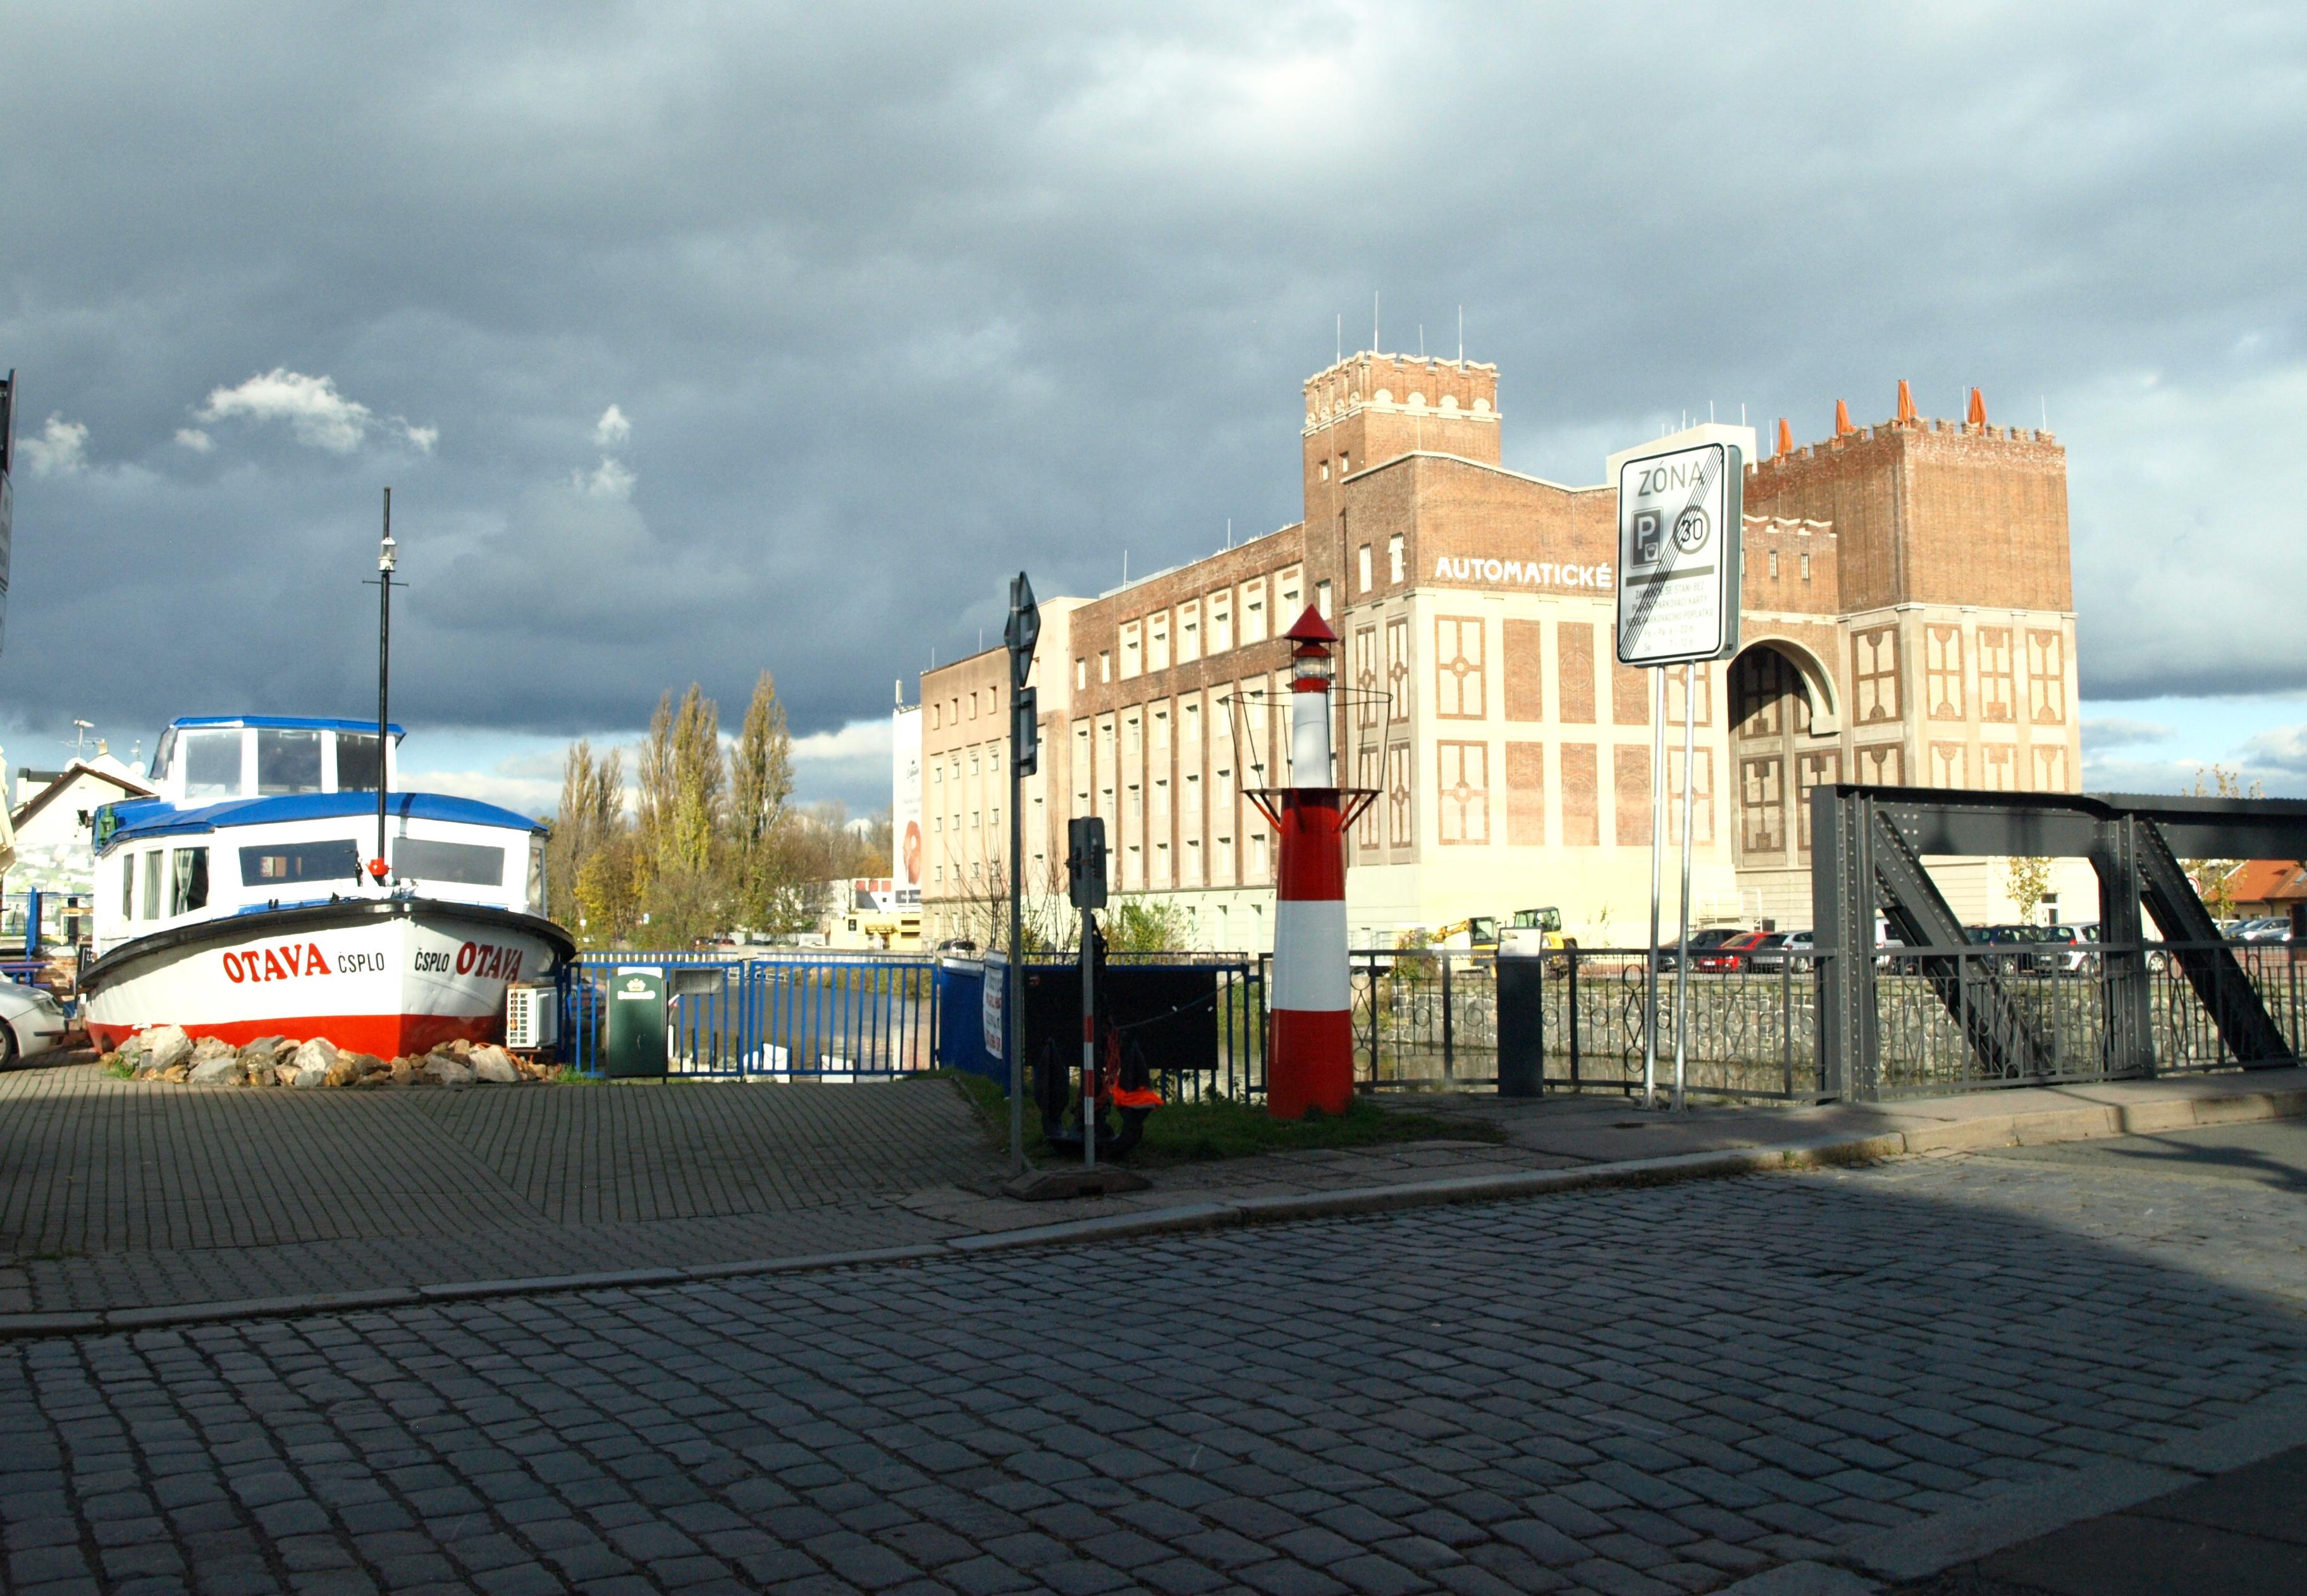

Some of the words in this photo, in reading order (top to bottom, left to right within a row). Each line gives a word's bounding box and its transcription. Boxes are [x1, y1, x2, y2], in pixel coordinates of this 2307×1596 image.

[1638, 460, 1704, 496] ZÓNA
[1637, 515, 1656, 549] P
[1682, 518, 1702, 542] 30
[1435, 556, 1613, 587] AUTOMATICKÉ
[223, 943, 332, 983] OTAVA
[338, 950, 385, 973] ČSPLO
[415, 947, 450, 973] ČSPLO
[456, 941, 524, 981] OTAVA
